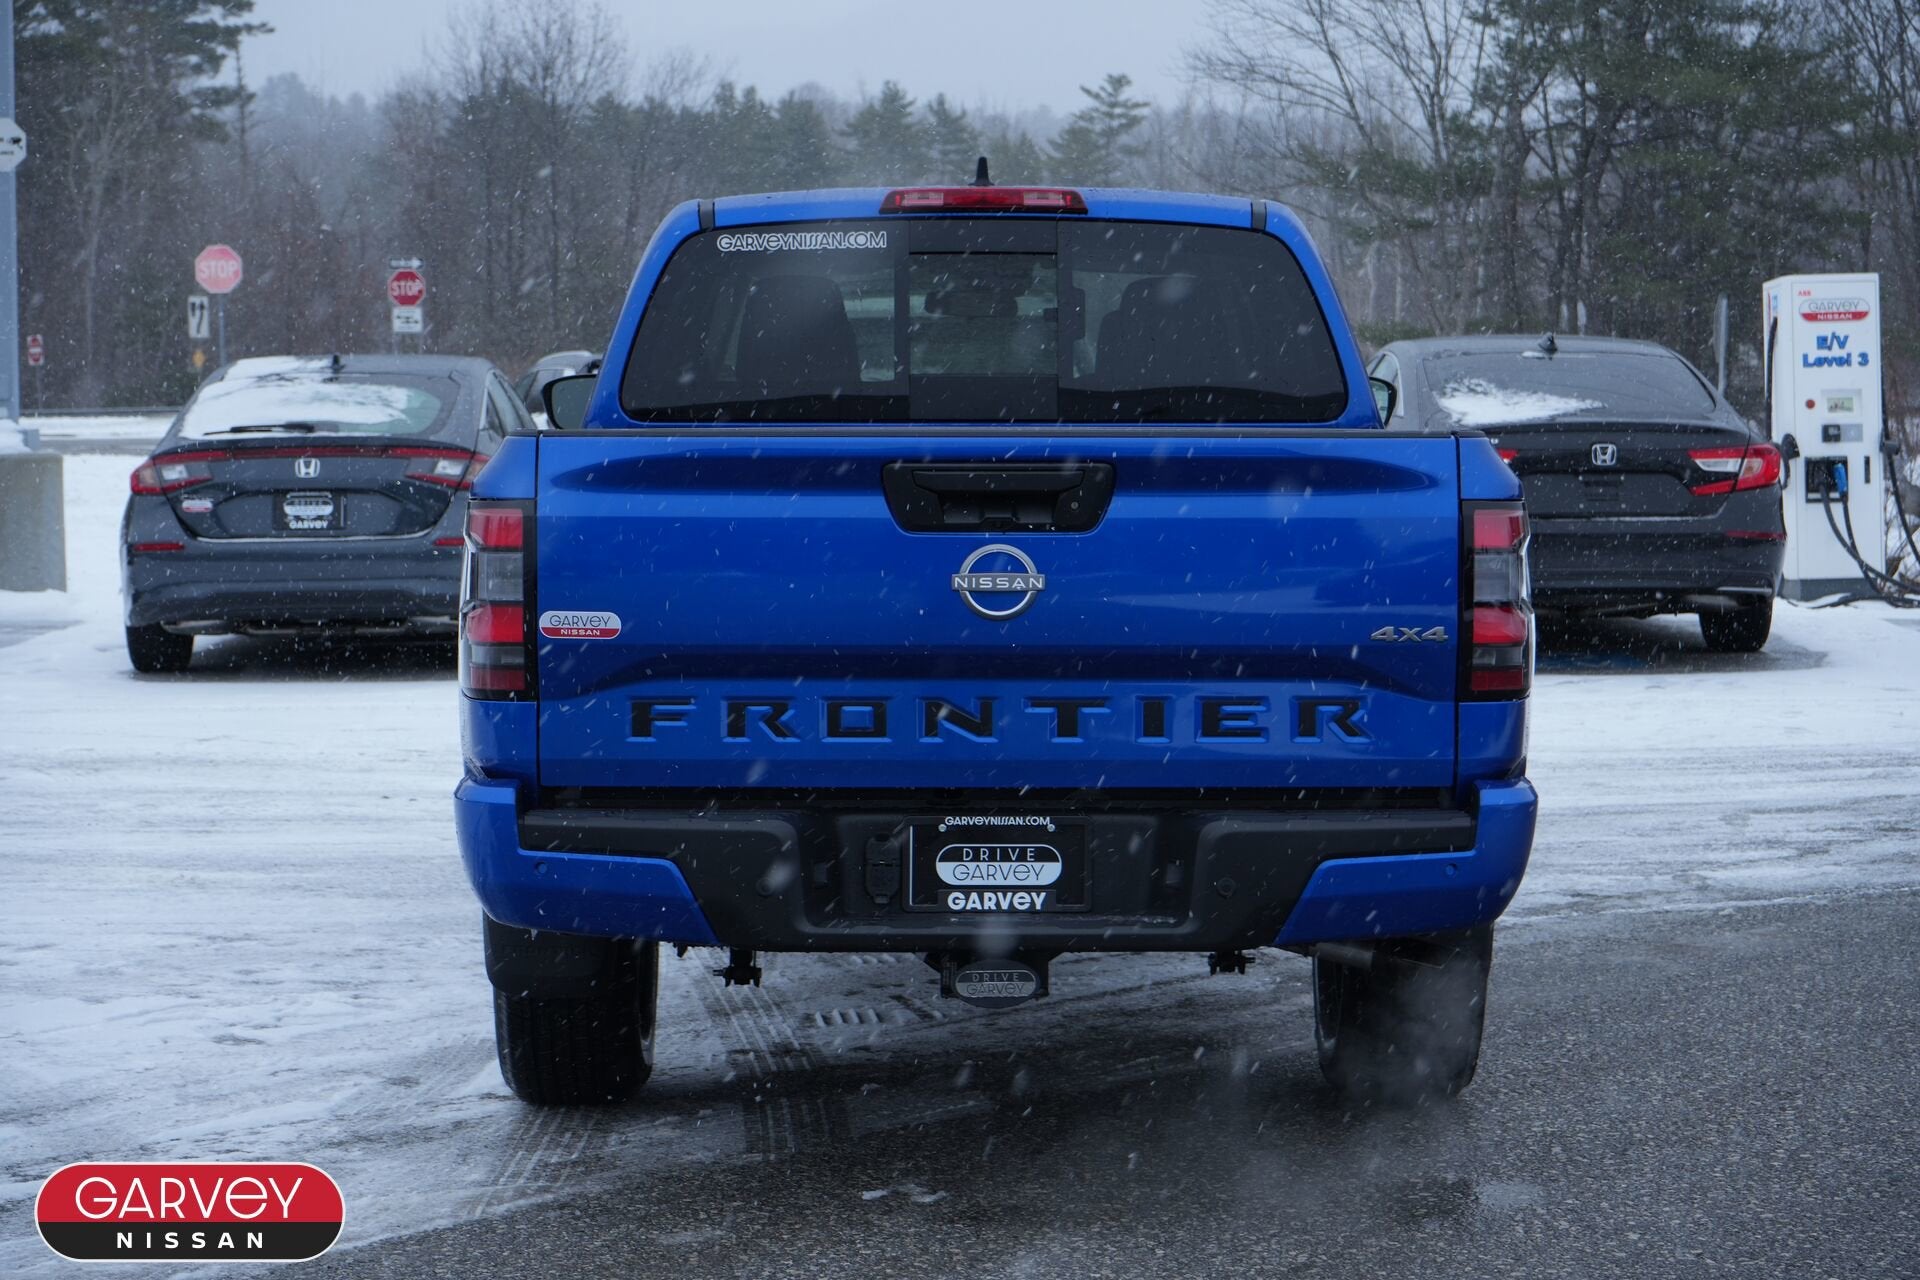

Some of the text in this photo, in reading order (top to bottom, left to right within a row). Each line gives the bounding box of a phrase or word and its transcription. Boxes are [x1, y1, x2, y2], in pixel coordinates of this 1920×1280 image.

[717, 231, 887, 252] GARVEYNISSAN.COM
[199, 259, 239, 279] STOP
[391, 280, 422, 297] STOP
[1816, 332, 1849, 351] E/V
[1802, 352, 1869, 368] Level 3
[954, 577, 1043, 588] NISSAN
[549, 614, 611, 628] GARVEY
[626, 696, 1372, 743] FRONTIER
[944, 816, 1051, 826] GARVEYNISSAN.COM
[963, 848, 1036, 861] DRIVE
[952, 864, 1045, 882] GARVEY
[947, 891, 1047, 910] GARVEY
[972, 973, 1020, 982] DRIVE
[966, 983, 1025, 995] GARVEY
